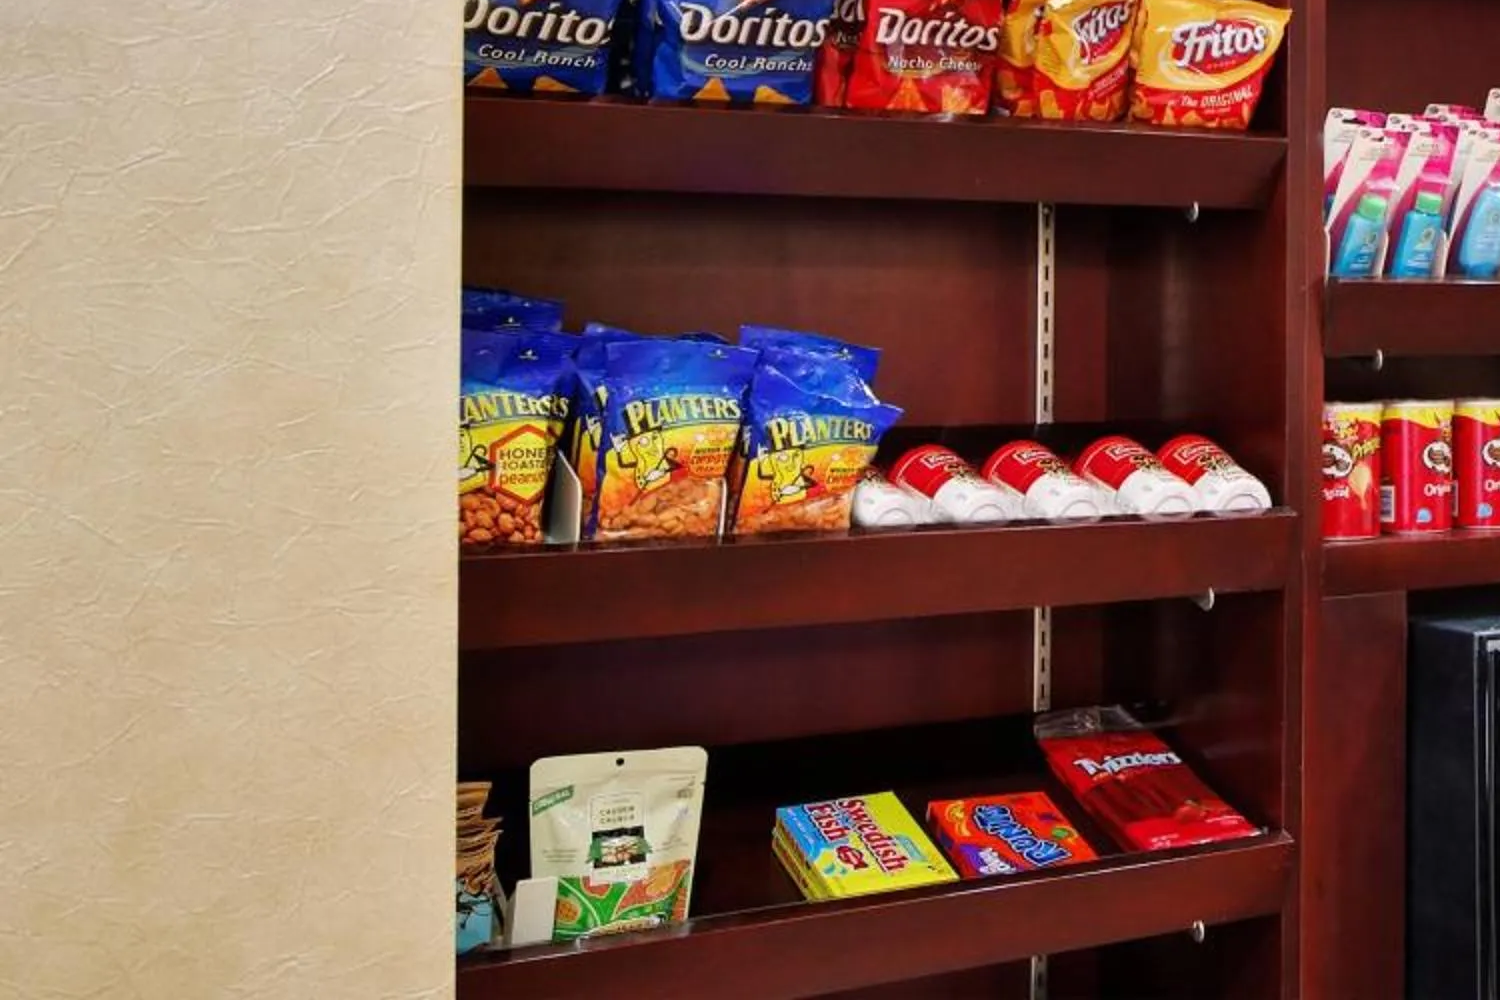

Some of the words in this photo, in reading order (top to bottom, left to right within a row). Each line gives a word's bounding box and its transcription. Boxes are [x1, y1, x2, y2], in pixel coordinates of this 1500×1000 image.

[679, 1, 832, 48] Doritos
[875, 7, 1000, 51] Doritos
[1171, 18, 1267, 68] Fritos
[478, 42, 525, 62] Cool
[532, 49, 596, 69] Ranch
[704, 52, 749, 71] Cool
[887, 54, 934, 71] Nacho
[625, 396, 741, 436] PLANTERS
[500, 447, 548, 459] HONE
[803, 803, 850, 842] Fish
[836, 797, 911, 873] Swedish
